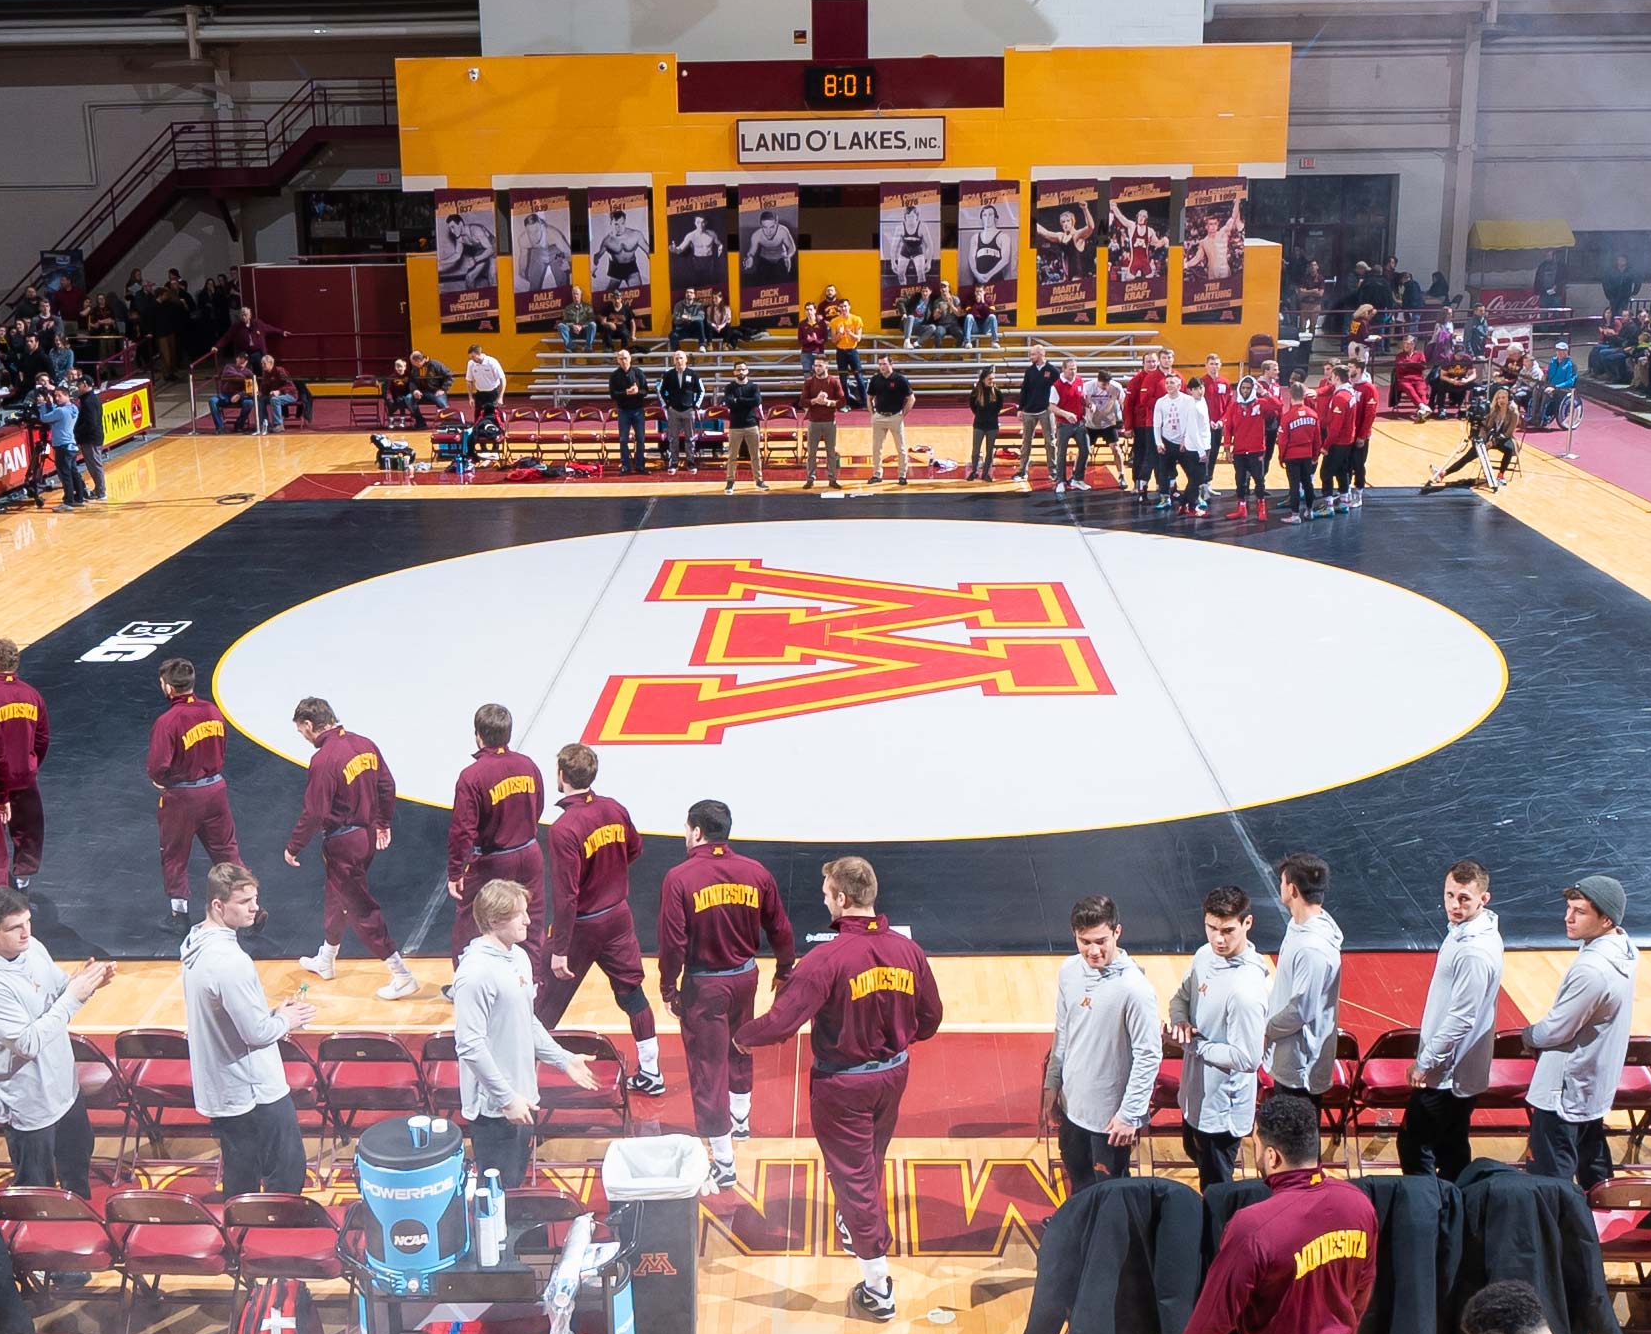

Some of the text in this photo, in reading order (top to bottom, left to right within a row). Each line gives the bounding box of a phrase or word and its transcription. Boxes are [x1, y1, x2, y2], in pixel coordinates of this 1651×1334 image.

[824, 75, 872, 97] 8:01
[741, 132, 801, 152] LAND
[915, 137, 941, 149] INC.
[760, 287, 779, 298] DICK
[1053, 283, 1081, 294] MARTY
[1125, 283, 1148, 293] CHAD
[1204, 283, 1220, 292] TIM
[458, 292, 479, 303] JOHN
[533, 291, 554, 302] DALE
[752, 295, 789, 307] MUELLER
[1050, 291, 1086, 304] MORGAN
[1124, 290, 1151, 302] KRAFT
[1193, 289, 1232, 302] HARTUNG
[693, 883, 759, 914] MINNESOTA
[850, 967, 915, 1001] MINNESOTA
[362, 1177, 455, 1202] POWERADE
[393, 1233, 429, 1247] NCAA
[1295, 1230, 1367, 1280] MINNESOTA
